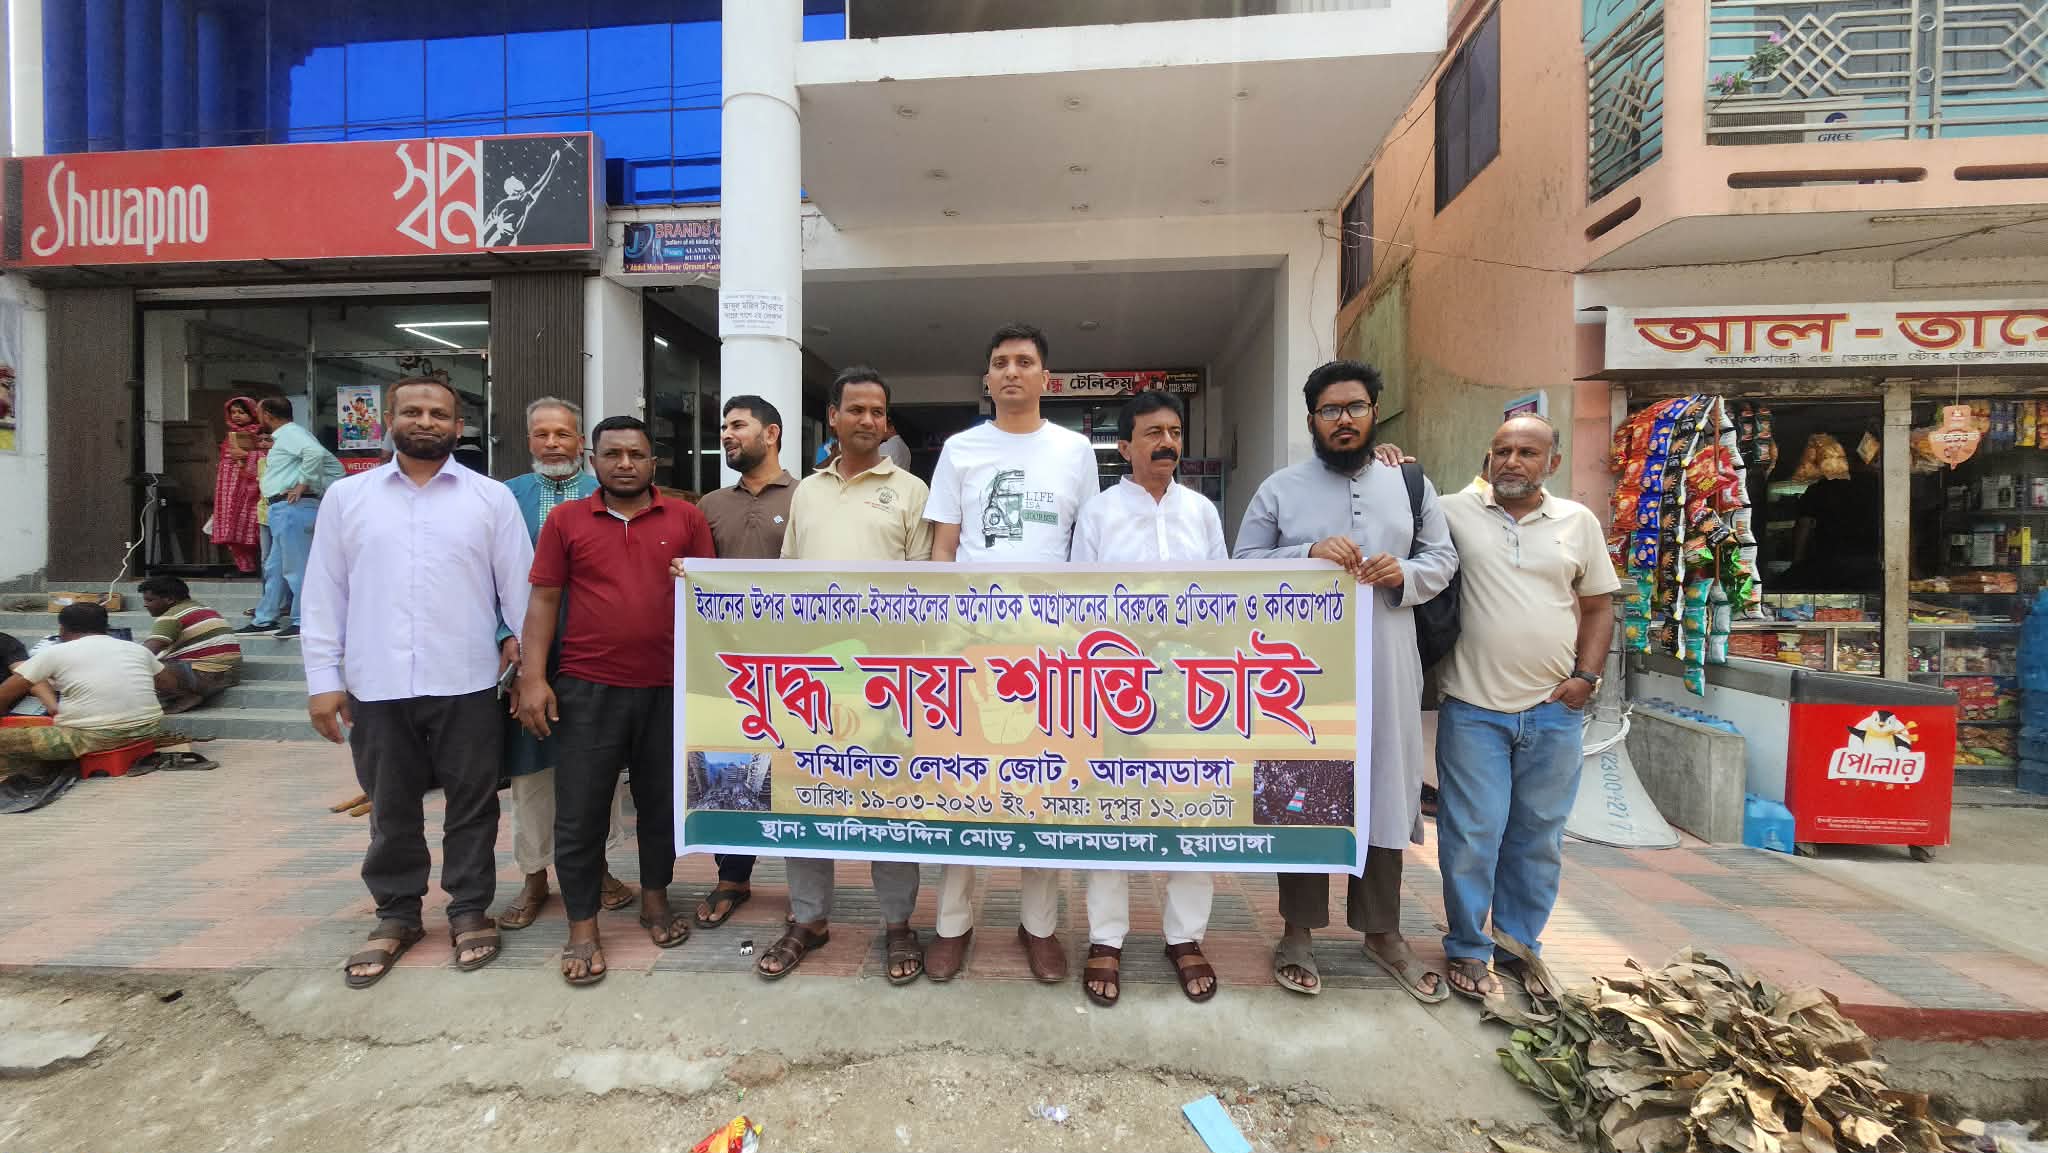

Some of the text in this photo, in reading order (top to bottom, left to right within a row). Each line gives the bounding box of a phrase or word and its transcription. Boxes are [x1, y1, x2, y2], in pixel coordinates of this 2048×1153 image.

[1817, 132, 1854, 142] GREE
[30, 161, 208, 257] Shwapno
[655, 222, 711, 239] BRANDS
[1025, 491, 1054, 503] LIFE
[692, 580, 1345, 627] ইরানের উপর আমেরিকা-ইসরাইলের অনৈতিক আগ্রাসনের বিরুদ্ধে প্রতিবাদ ও কবিতাপাঠ
[717, 630, 1322, 747] যুদ্ধ নয় শান্তি চাই
[793, 744, 901, 779] সম্মিলিত
[909, 752, 989, 782] লেখক
[1088, 757, 1235, 787] আলমডাঙ্গা
[1837, 751, 1917, 782] পোলার
[861, 789, 993, 815] ১৯-০৩-২০২৬
[1099, 797, 1144, 822] দুপুর
[814, 817, 952, 845] আলিফউদ্দিন
[1176, 832, 1275, 857] চুয়াডাঙ্গা
